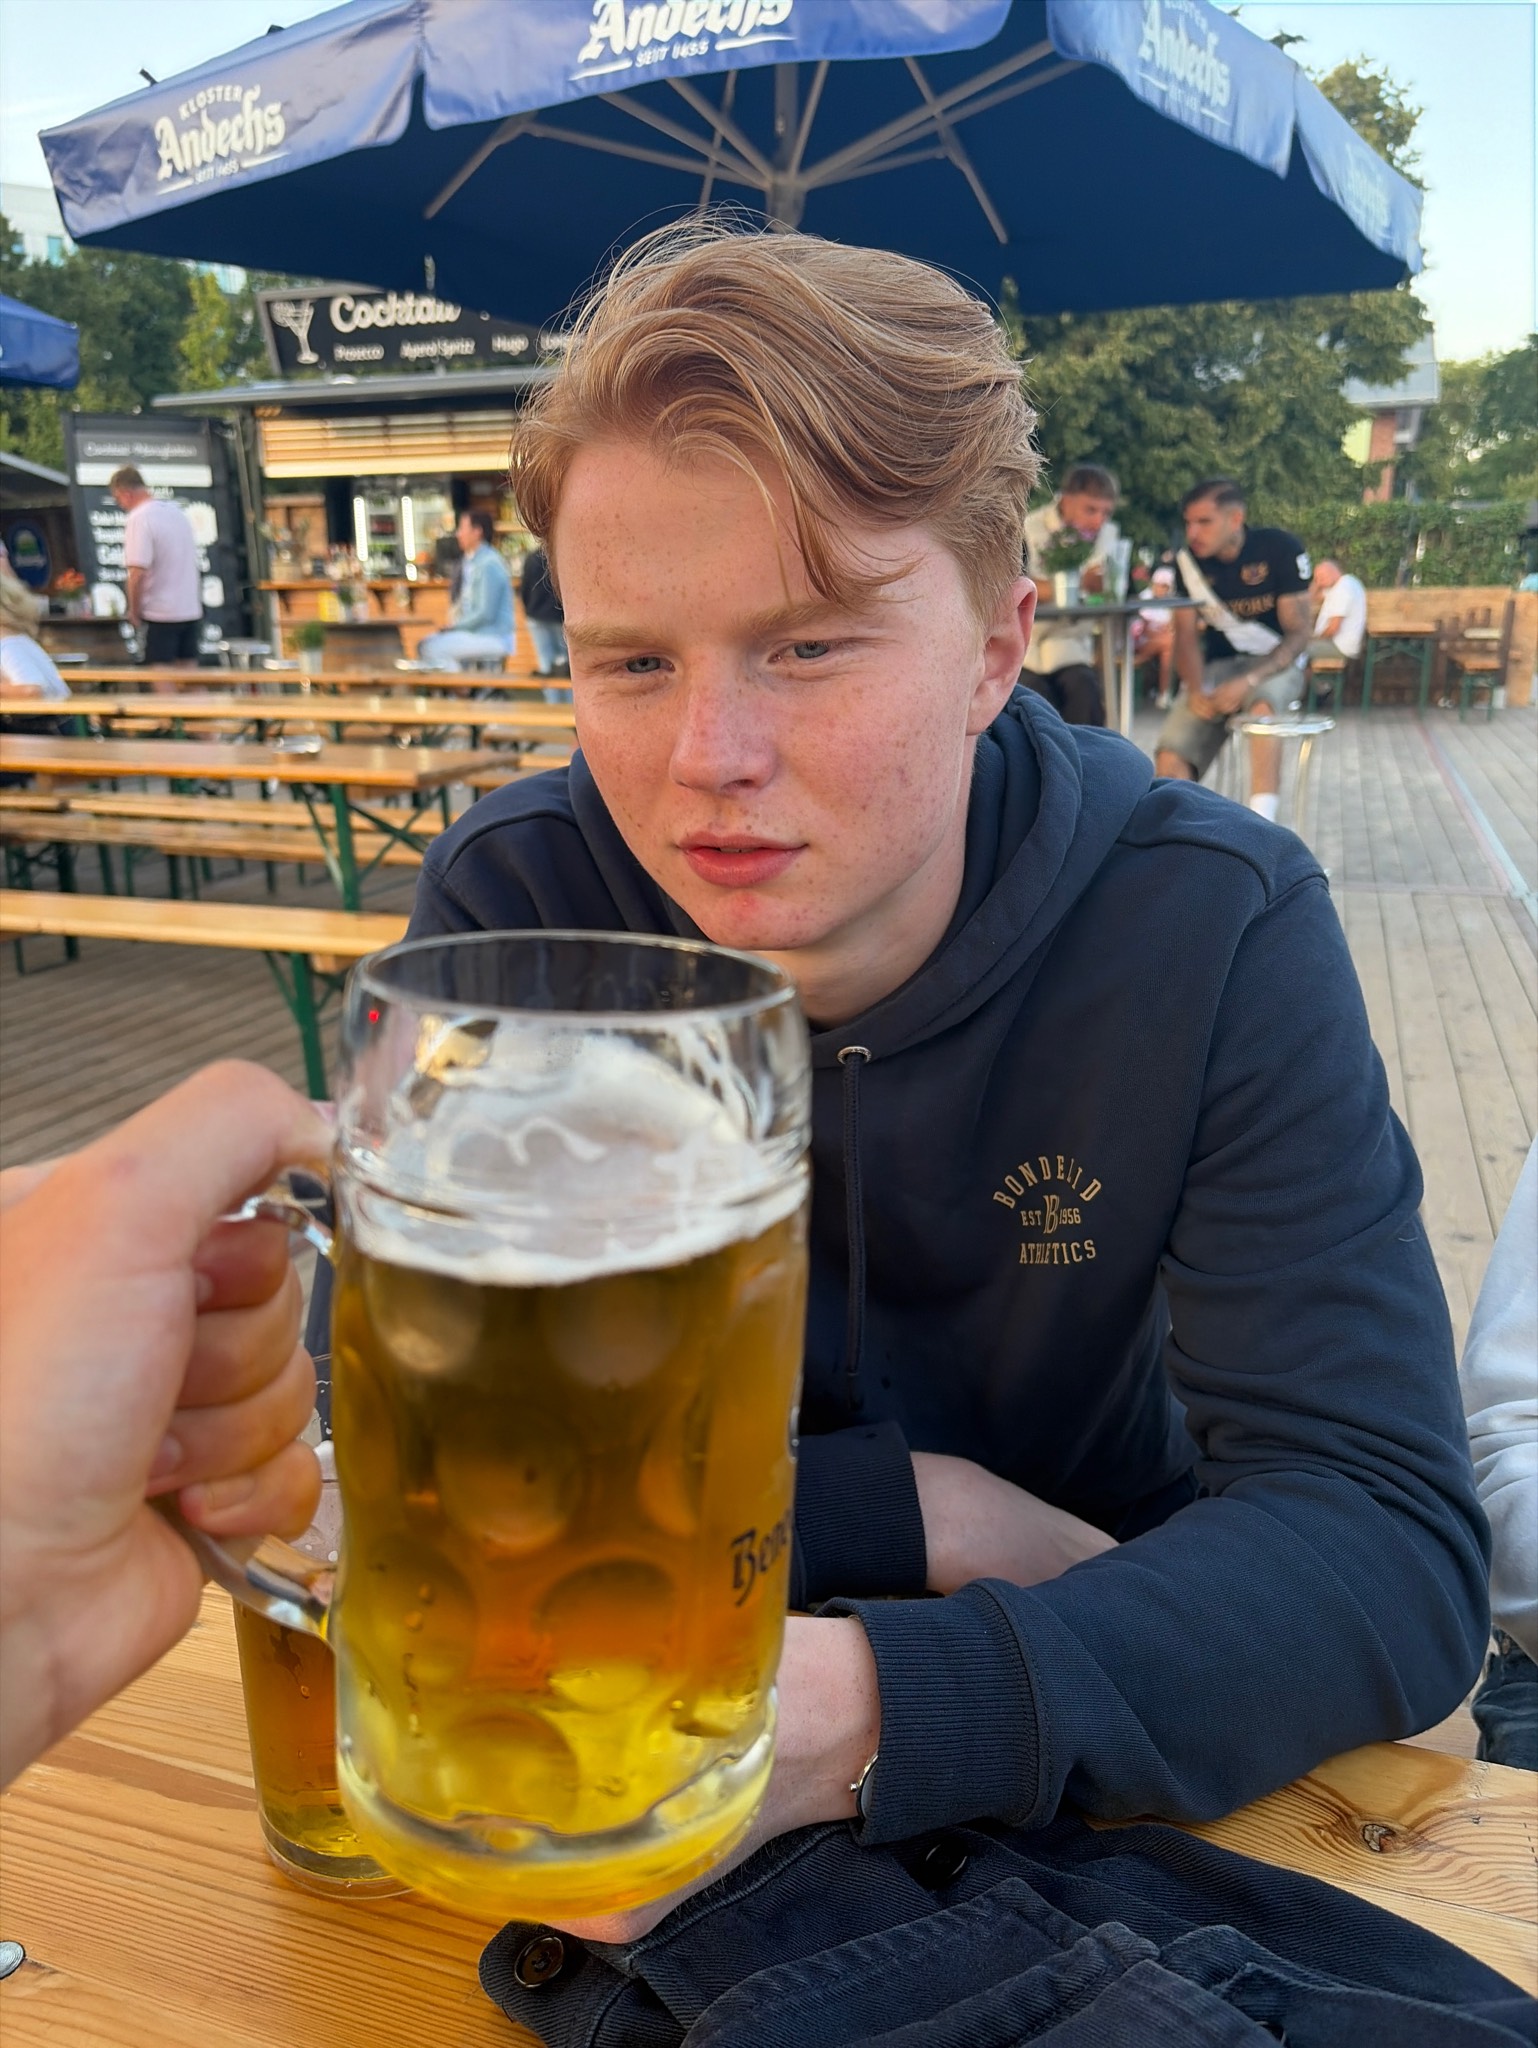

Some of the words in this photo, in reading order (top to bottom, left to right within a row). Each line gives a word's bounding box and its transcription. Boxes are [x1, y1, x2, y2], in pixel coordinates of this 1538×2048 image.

[178, 84, 243, 121] KLOSTER
[154, 84, 286, 181] Andechs
[1020, 1210, 1042, 1226] EST
[1059, 1207, 1082, 1225] 1956
[1019, 1239, 1097, 1264] ATHLETICS
